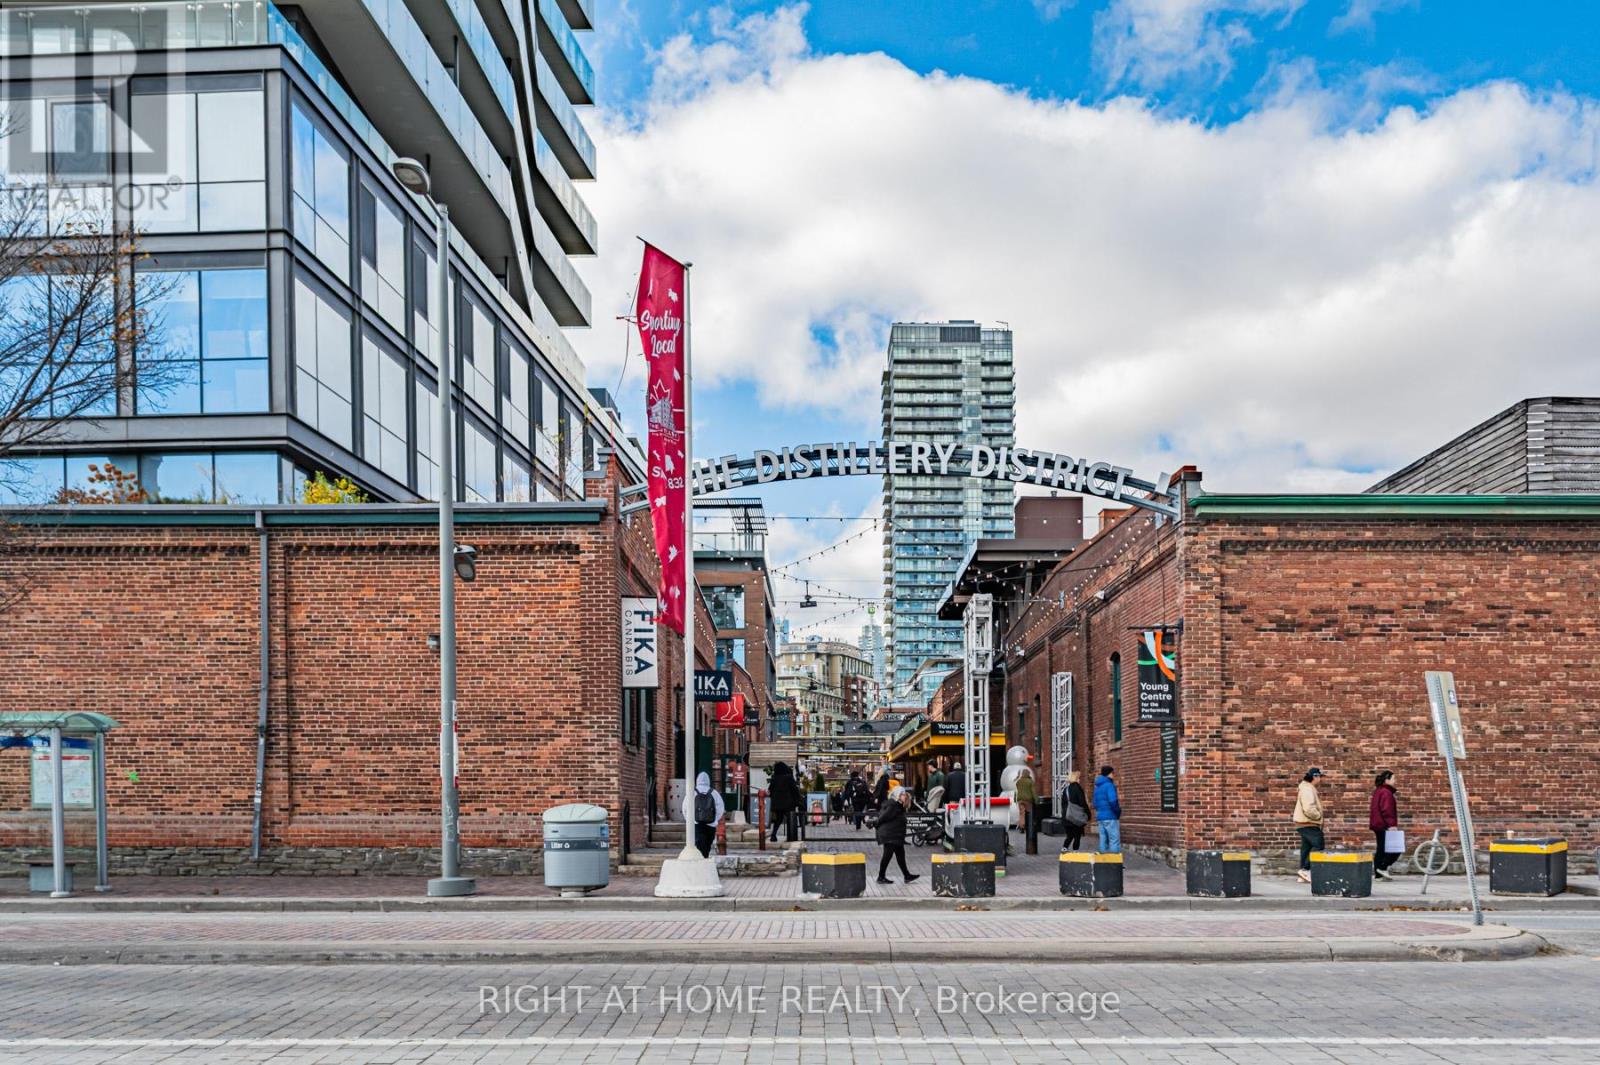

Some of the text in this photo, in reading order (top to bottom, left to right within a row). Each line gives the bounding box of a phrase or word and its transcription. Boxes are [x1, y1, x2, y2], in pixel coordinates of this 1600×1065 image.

[640, 309, 682, 336] Sporting
[651, 333, 677, 358] Local
[693, 440, 1134, 500] HE DISTILLERY DISTRICT
[666, 476, 685, 489] 832
[624, 609, 634, 676] CANNABIS
[633, 610, 655, 675] FIKA
[694, 675, 729, 691] IKA
[1140, 682, 1169, 692] Young
[1140, 692, 1173, 701] Centre
[937, 723, 959, 731] Young
